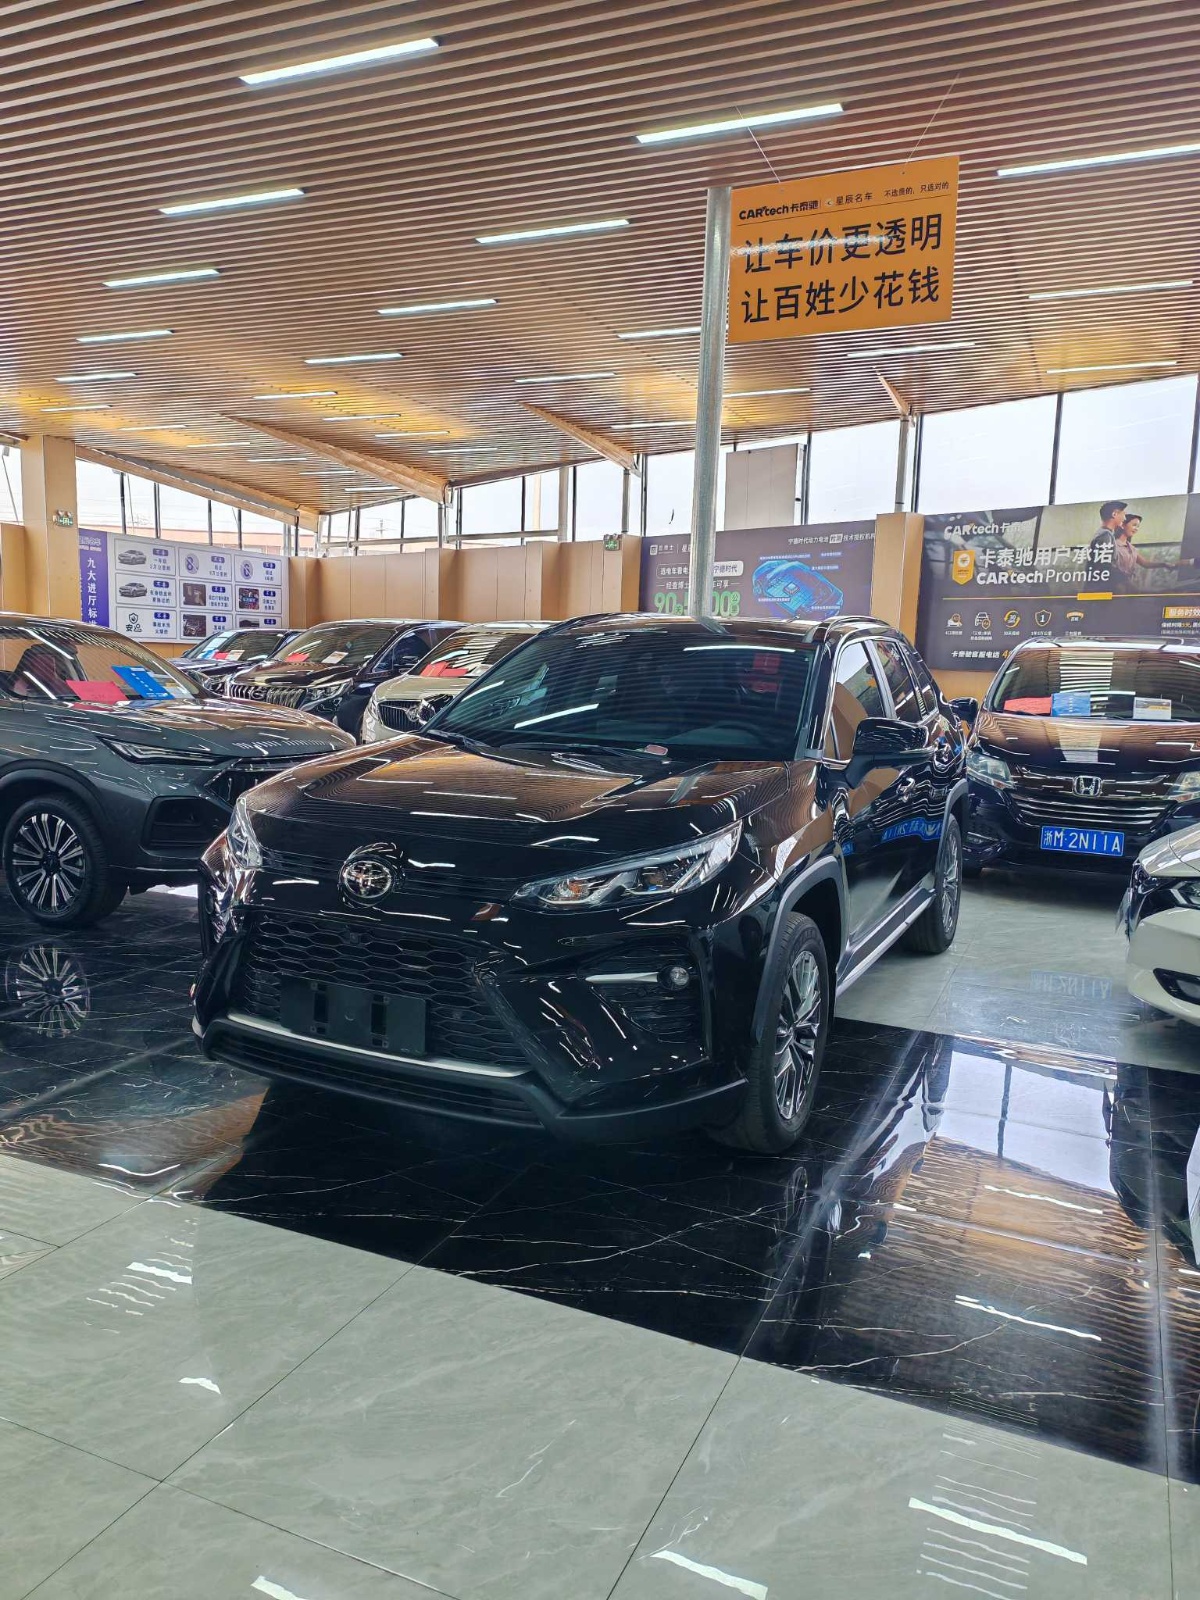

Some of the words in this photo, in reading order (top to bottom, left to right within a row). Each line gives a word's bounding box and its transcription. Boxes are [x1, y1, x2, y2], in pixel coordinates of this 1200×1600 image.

[745, 213, 942, 273] 让车价更透明
[741, 266, 940, 324] 让百姓少花钱
[980, 543, 1114, 568] 卡泰驰用户承诺
[1045, 566, 1110, 583] Promise
